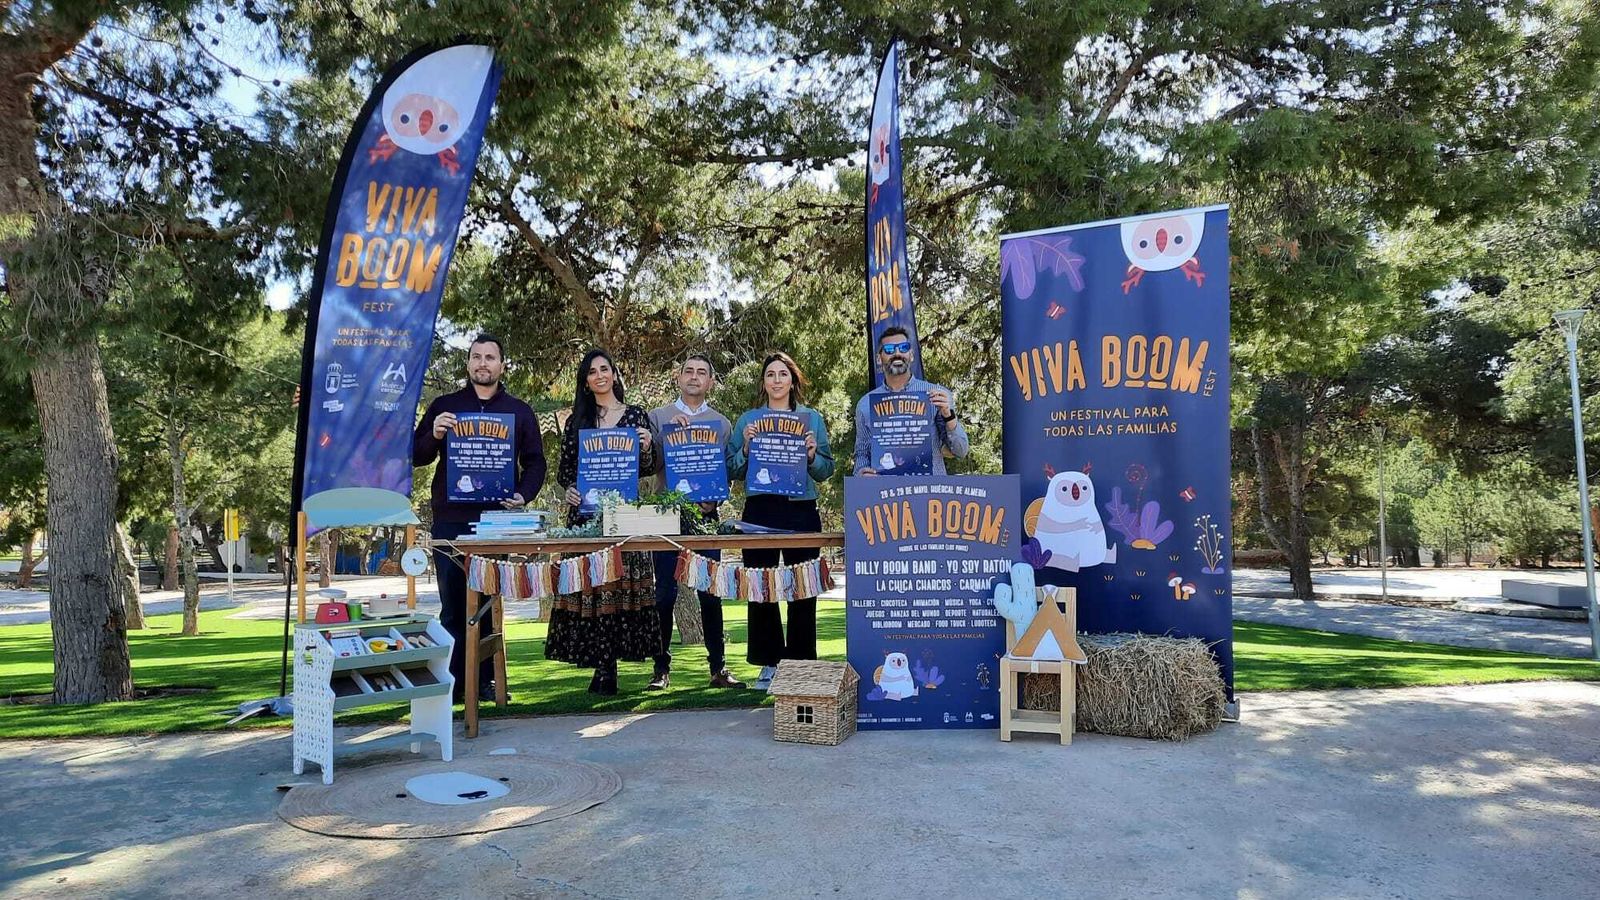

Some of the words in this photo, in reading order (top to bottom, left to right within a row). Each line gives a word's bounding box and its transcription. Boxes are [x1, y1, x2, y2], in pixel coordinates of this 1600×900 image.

[366, 180, 438, 236] VIVA
[336, 233, 443, 294] BOOM
[363, 302, 394, 312] FEST
[1010, 339, 1087, 401] VIVA
[1102, 335, 1209, 394] BOOM
[1203, 369, 1217, 397] FEST
[872, 400, 894, 416] VIVA
[898, 400, 925, 416] BOOM
[1051, 410, 1067, 421] UN
[1070, 407, 1130, 420] FESTIVAL
[1134, 405, 1169, 417] PARA
[453, 421, 475, 438] VIVA
[479, 421, 508, 440] BOOM
[754, 418, 774, 432] VIVA
[778, 418, 805, 436] BOOM
[1044, 425, 1084, 437] TODAS
[1088, 424, 1113, 436] LAS
[1117, 422, 1177, 435] FAMILIAS
[583, 437, 604, 453] VIVA
[607, 436, 634, 452] BOOM
[667, 430, 688, 448] VIVA
[691, 430, 718, 444] BOOM
[880, 490, 888, 499] 28
[890, 489, 896, 497] &
[896, 488, 904, 496] 29
[905, 486, 912, 495] DE
[930, 484, 954, 494] HUÉRCAL
[956, 486, 964, 495] DE
[964, 487, 986, 498] ALMERÍA
[856, 500, 917, 546] VIVA
[928, 500, 1005, 545] BOOM
[1001, 528, 1010, 548] FEST
[856, 560, 879, 575] BILLY
[883, 560, 908, 574] BOOM
[912, 560, 937, 574] BAND
[947, 560, 958, 574] YO
[962, 560, 980, 574] SOY
[984, 558, 1012, 574] RATÓN
[876, 579, 886, 592] LA
[889, 578, 913, 594] CHICA
[916, 578, 952, 592] CHARCOS
